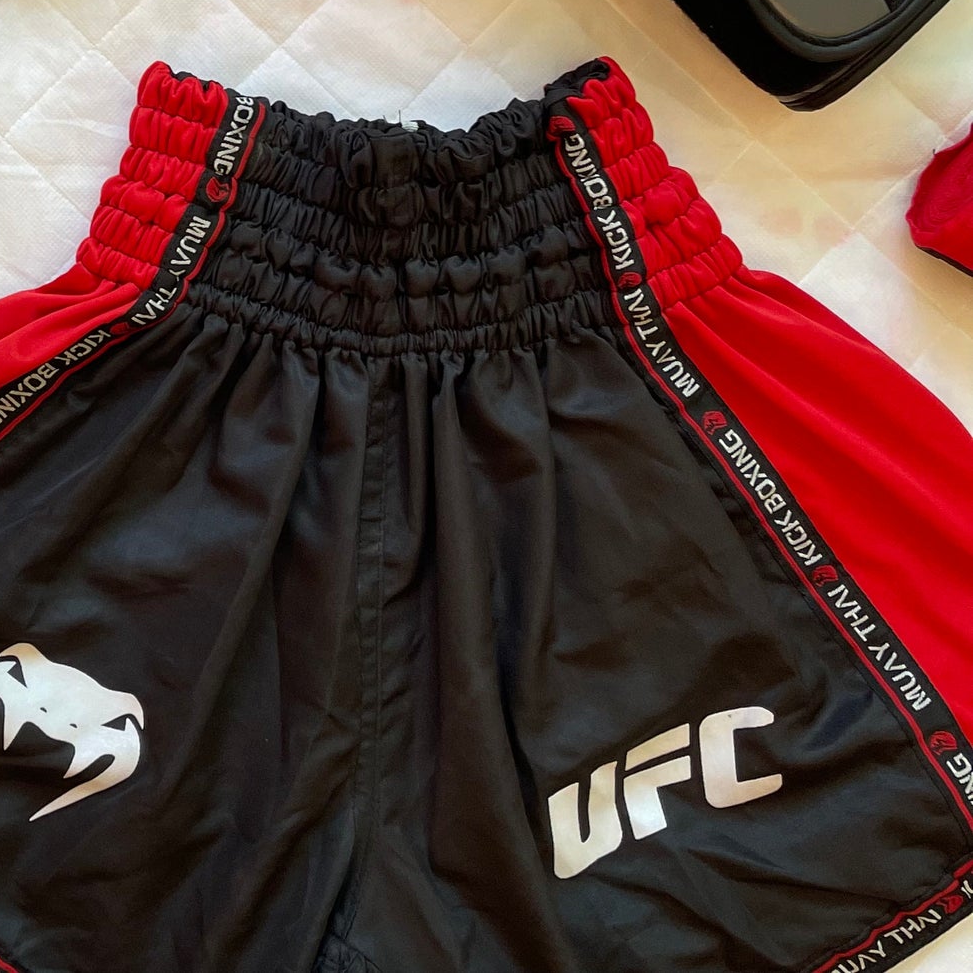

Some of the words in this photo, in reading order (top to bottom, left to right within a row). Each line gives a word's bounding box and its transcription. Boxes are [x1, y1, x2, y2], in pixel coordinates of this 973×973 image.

[563, 133, 613, 211] BOXING
[169, 214, 212, 282] MUAY
[597, 209, 635, 270] KICK
[130, 285, 178, 326] THAI
[623, 288, 658, 341] THAI
[55, 329, 112, 366] KICK
[645, 340, 700, 398] MUAY
[719, 429, 787, 514] BOXING
[774, 509, 823, 566] KICK
[827, 584, 876, 642] THAI
[868, 642, 932, 711] MUAY
[547, 706, 783, 879] UFC
[831, 940, 886, 973] UAY
[884, 909, 942, 945] THAI
